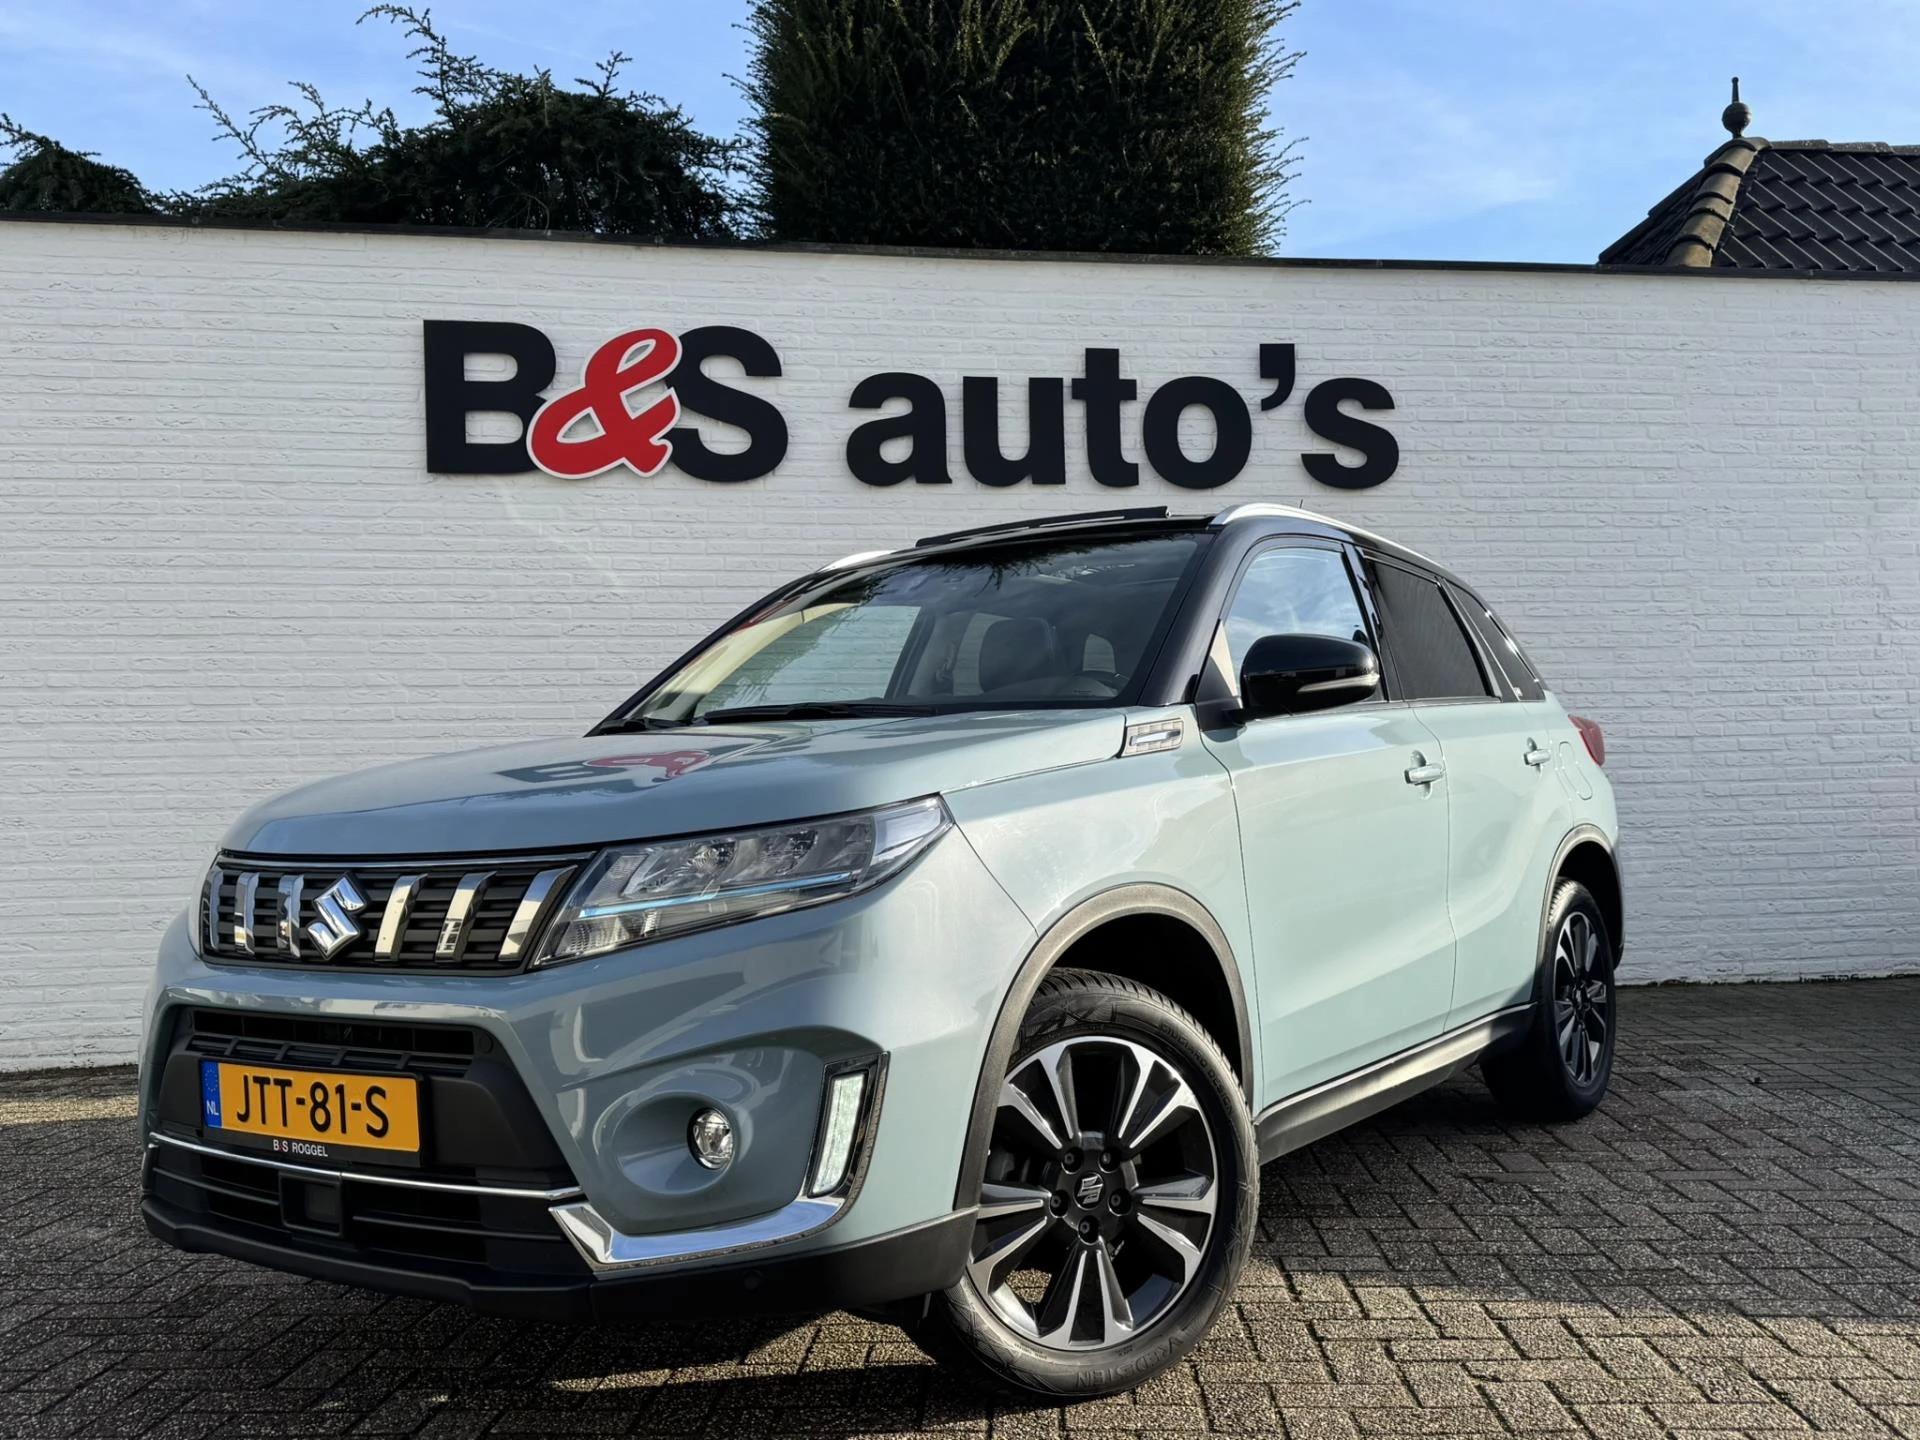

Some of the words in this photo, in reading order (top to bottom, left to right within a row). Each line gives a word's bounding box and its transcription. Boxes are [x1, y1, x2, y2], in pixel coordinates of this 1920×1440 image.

[423, 319, 788, 482] B&S
[846, 343, 1399, 489] auto's
[206, 1099, 219, 1116] NL
[236, 1074, 390, 1139] JTT-81-S
[291, 1142, 329, 1157] ROGGEL
